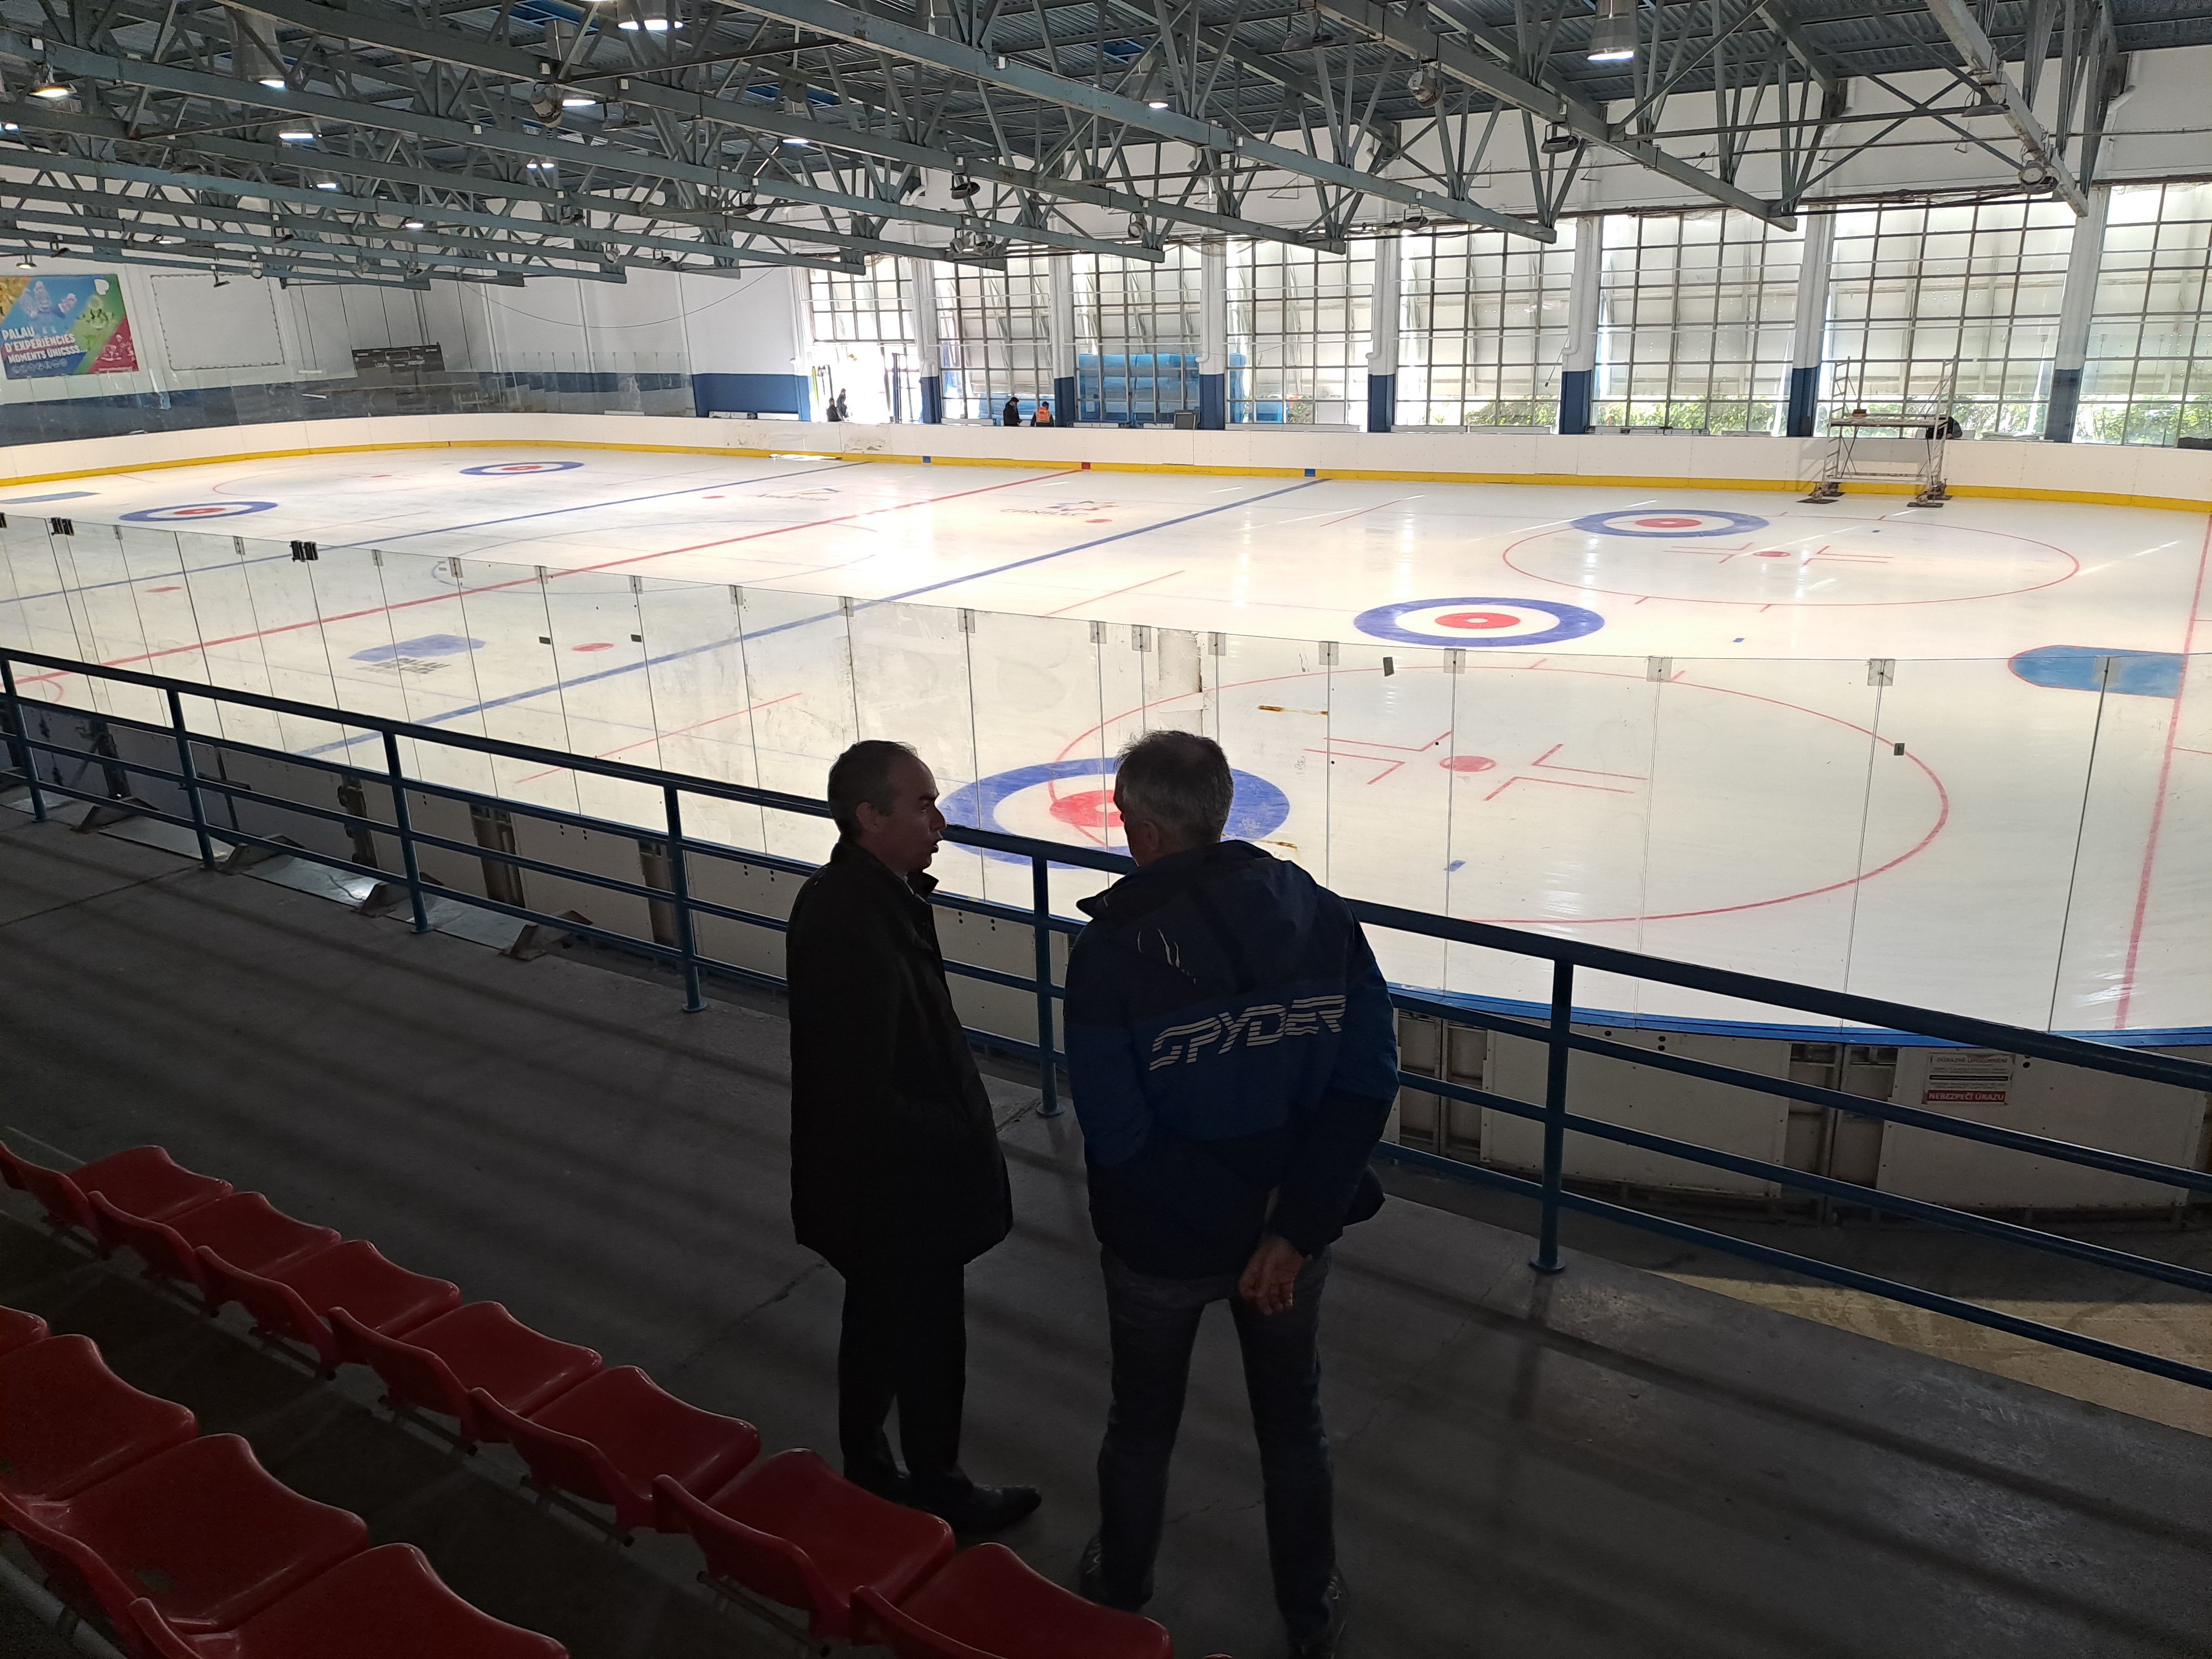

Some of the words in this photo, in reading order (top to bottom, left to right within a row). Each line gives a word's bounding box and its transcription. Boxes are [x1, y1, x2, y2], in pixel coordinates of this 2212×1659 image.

[1, 326, 35, 341] PALAU
[8, 349, 47, 364] MOMENTS
[1149, 994, 1347, 1071] SPYDER
